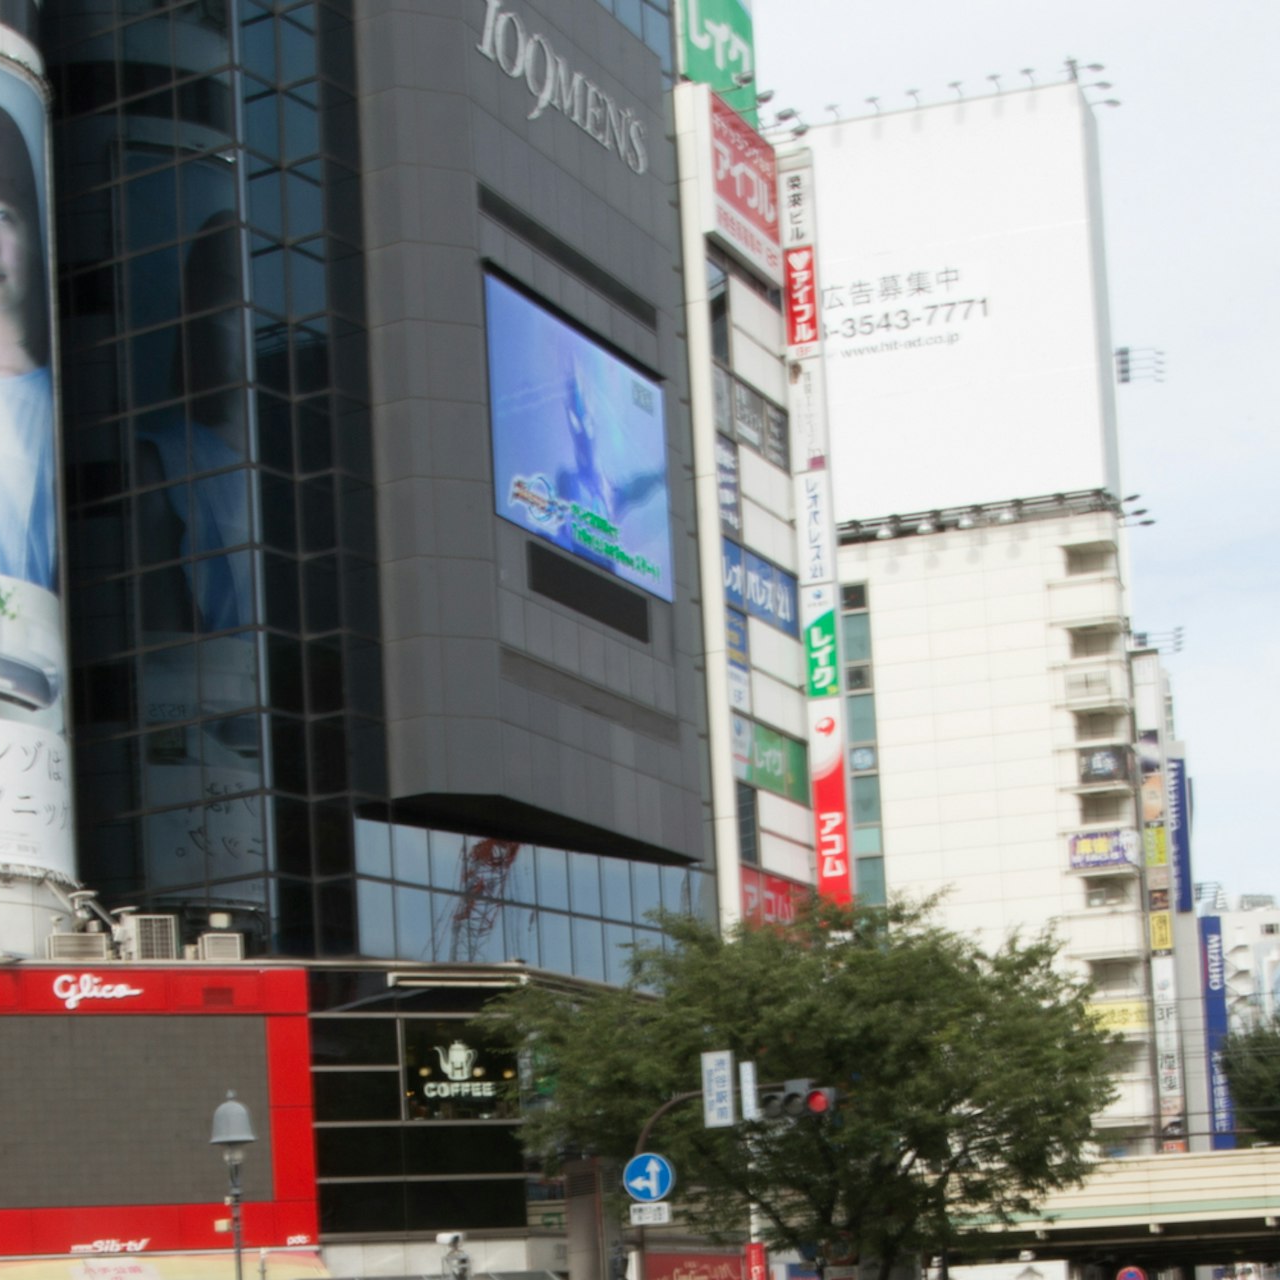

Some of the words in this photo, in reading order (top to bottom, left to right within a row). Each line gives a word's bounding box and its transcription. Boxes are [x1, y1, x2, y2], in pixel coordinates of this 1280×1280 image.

[791, 270, 816, 344] アイフル
[821, 266, 960, 310] 広告募集中
[807, 478, 826, 581] レオパレス21
[723, 555, 791, 623] レオパレス21
[810, 626, 836, 690] レイク
[819, 811, 847, 878] アコム
[53, 974, 144, 1009] Glico
[1206, 933, 1225, 991] MIZUHO
[424, 1081, 495, 1098] COFFEE
